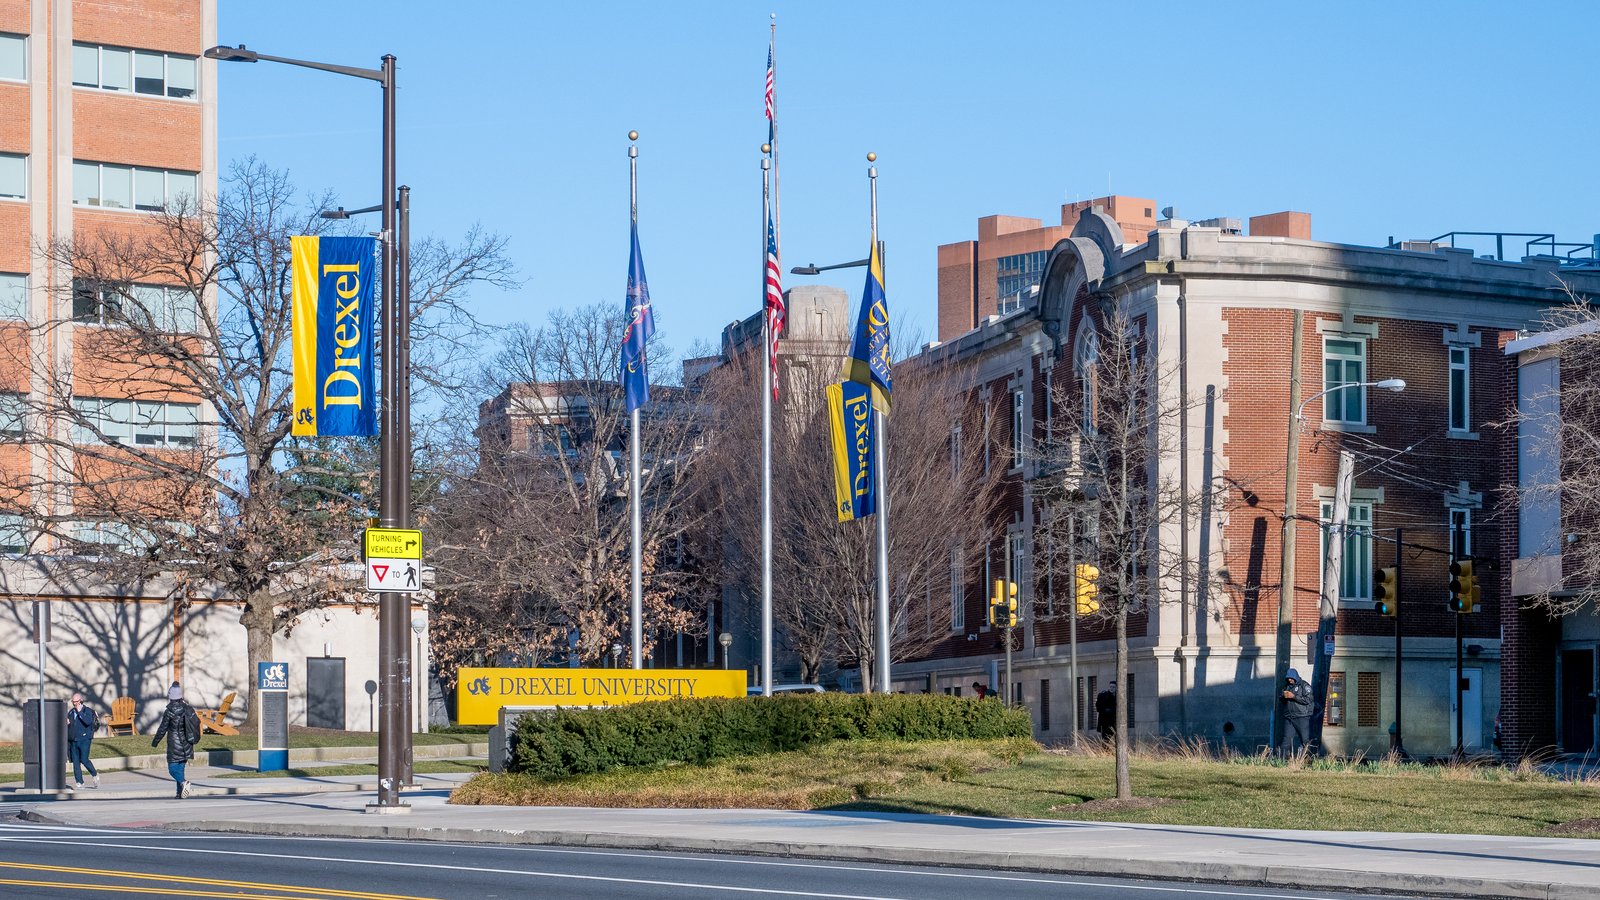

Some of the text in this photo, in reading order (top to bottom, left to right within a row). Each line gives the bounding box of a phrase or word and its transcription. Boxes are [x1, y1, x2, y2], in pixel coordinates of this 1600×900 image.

[323, 261, 362, 410] Drexel
[846, 392, 871, 499] Drexel
[371, 534, 402, 542] TURNING
[371, 545, 403, 553] VEHICLES
[263, 679, 287, 688] Drexel
[500, 677, 698, 697] DREXEL UNIVERSITY
